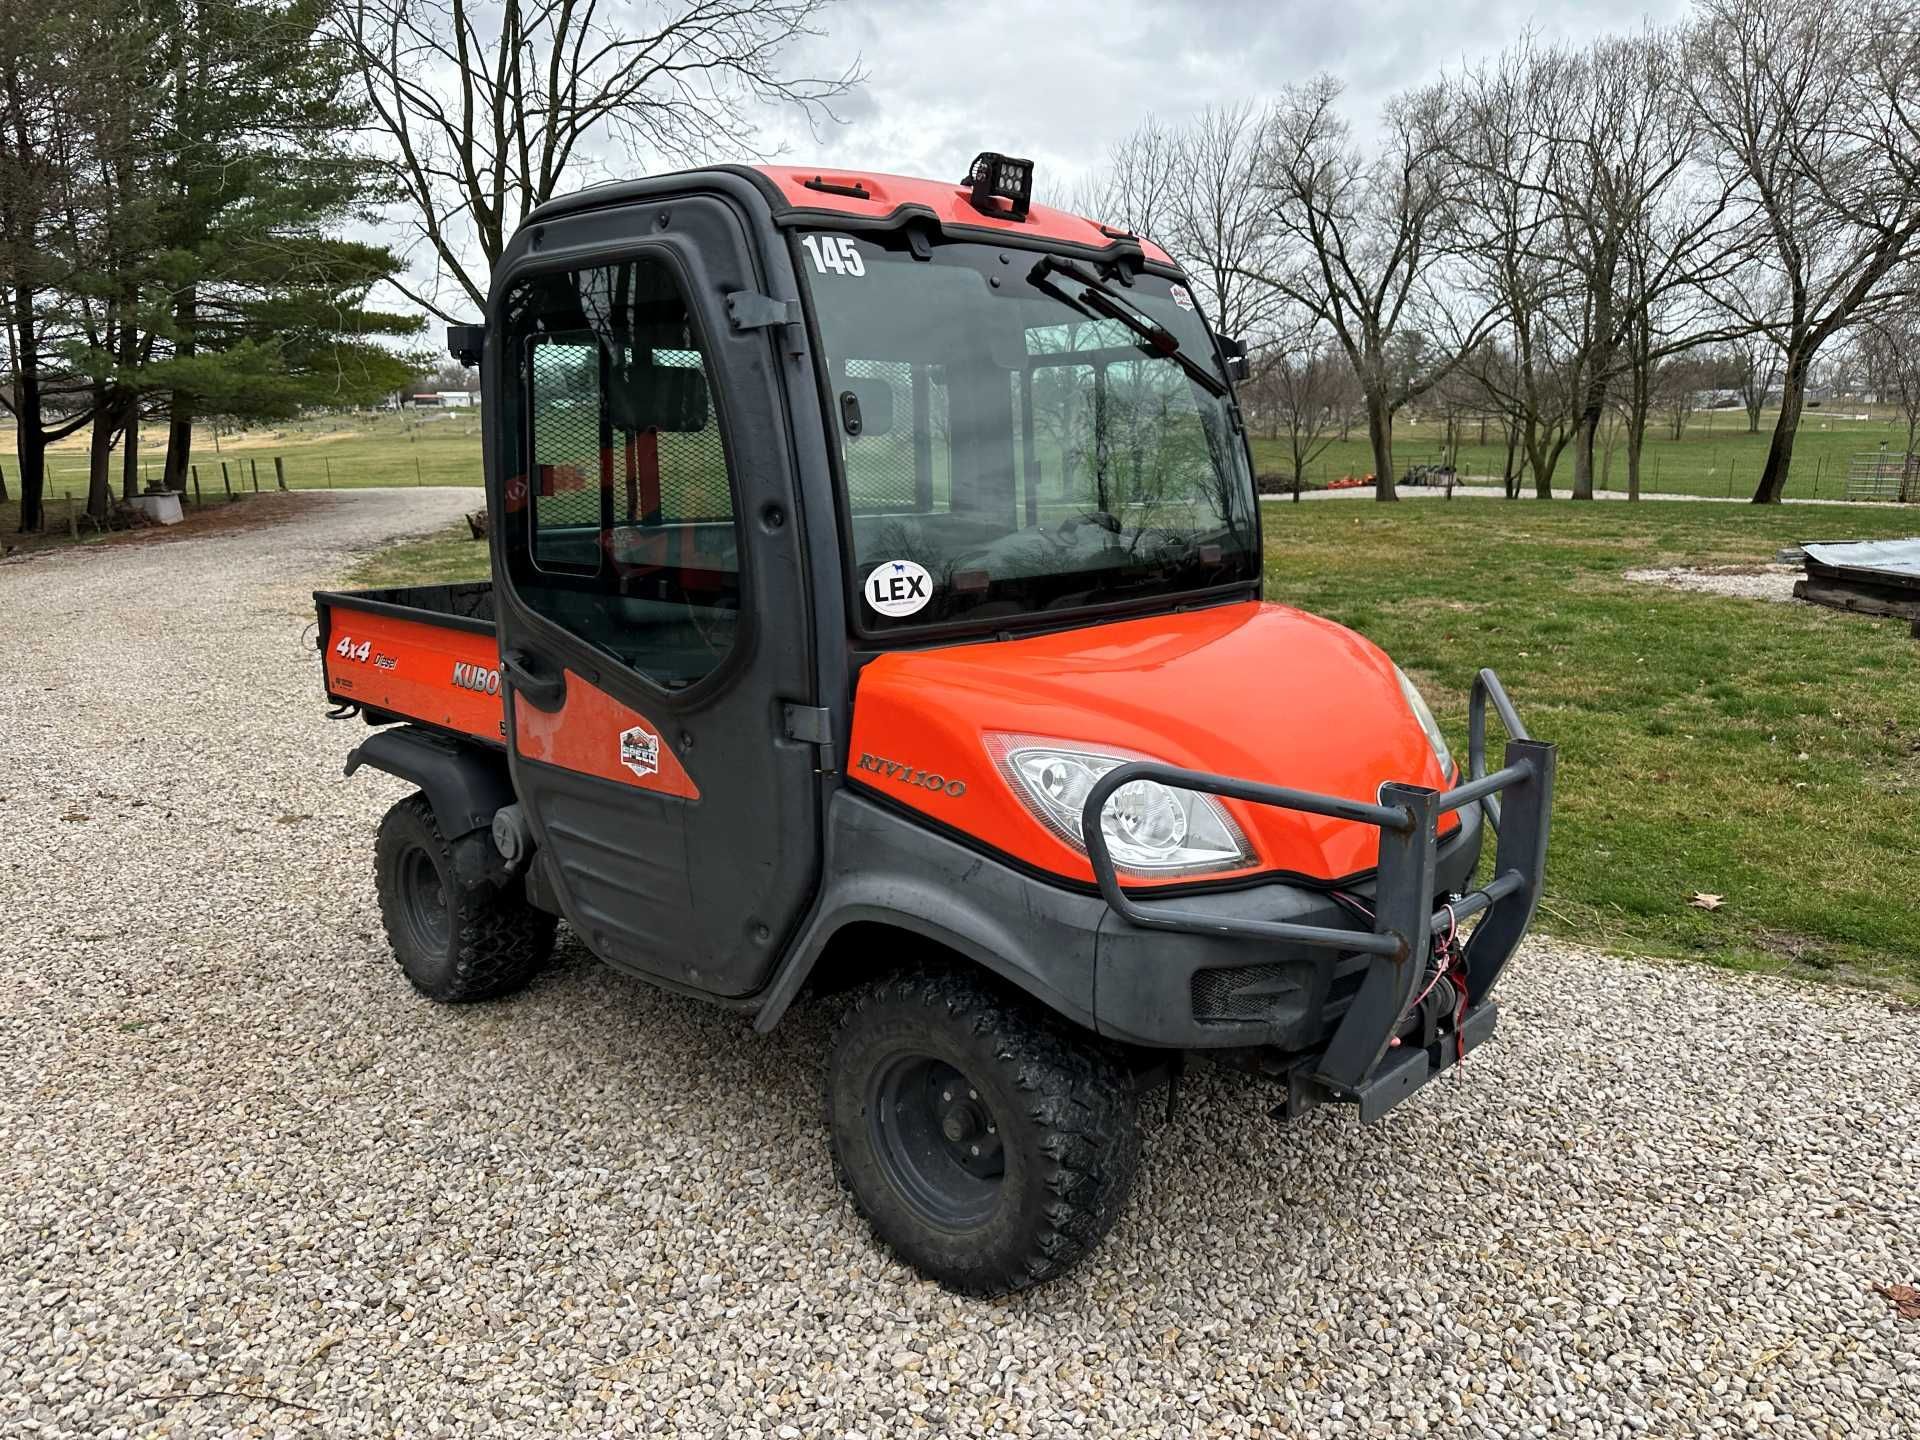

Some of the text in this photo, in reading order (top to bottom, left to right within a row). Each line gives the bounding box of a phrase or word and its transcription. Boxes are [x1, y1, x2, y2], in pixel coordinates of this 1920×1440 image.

[802, 235, 866, 277] 145
[873, 575, 926, 603] LEX
[336, 636, 399, 670] 4x4 Diesel
[857, 752, 967, 798] RTV1100
